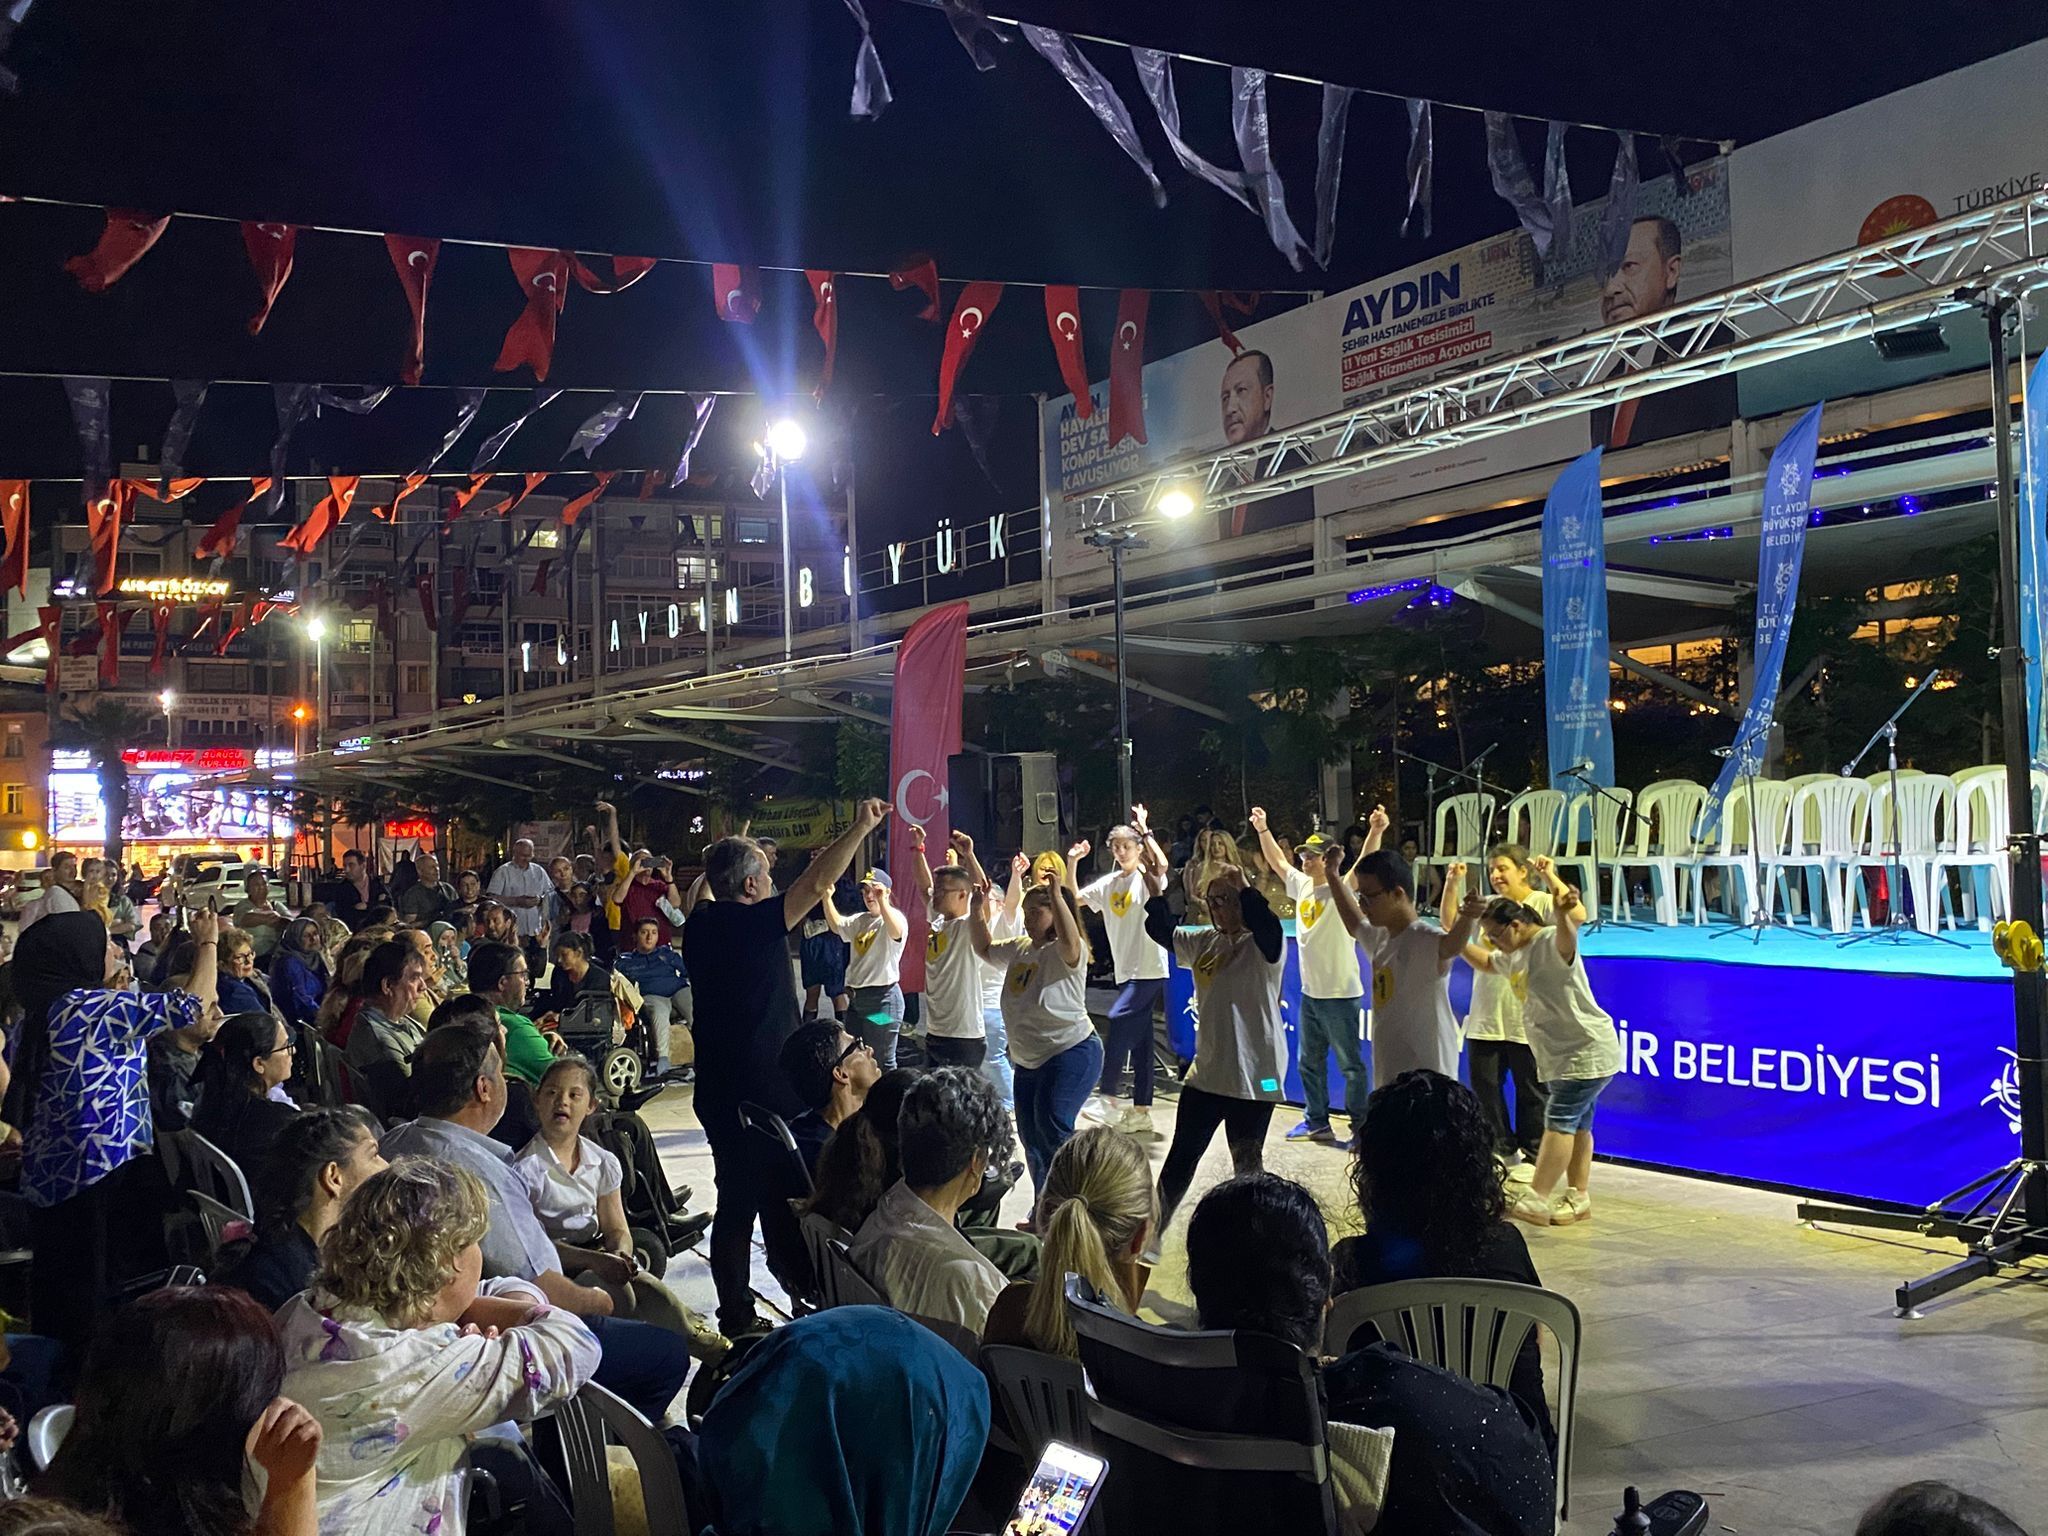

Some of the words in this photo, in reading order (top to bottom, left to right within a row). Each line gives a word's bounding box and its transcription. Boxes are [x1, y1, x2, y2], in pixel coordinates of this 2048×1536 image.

[1953, 172, 2040, 211] TÜRKİYE
[1342, 263, 1460, 337] AYDIN
[1342, 335, 1369, 353] ŞEHİR
[1370, 308, 1447, 343] HASTANEMİZLE
[1449, 292, 1496, 316] BİRLİKTE
[1343, 358, 1353, 371] 11
[1354, 349, 1378, 367] Yeni
[1379, 338, 1414, 360] Sağlık
[1416, 317, 1474, 347] Tesisimizi
[1343, 370, 1377, 390] Sağlık
[1378, 352, 1436, 376] Hizmetine
[1438, 334, 1491, 360] Açıyoruz
[1061, 433, 1088, 457] DEV
[1063, 454, 1140, 491] KAVUŞUYOR
[1673, 1042, 1941, 1108] BELEDİYESİ
